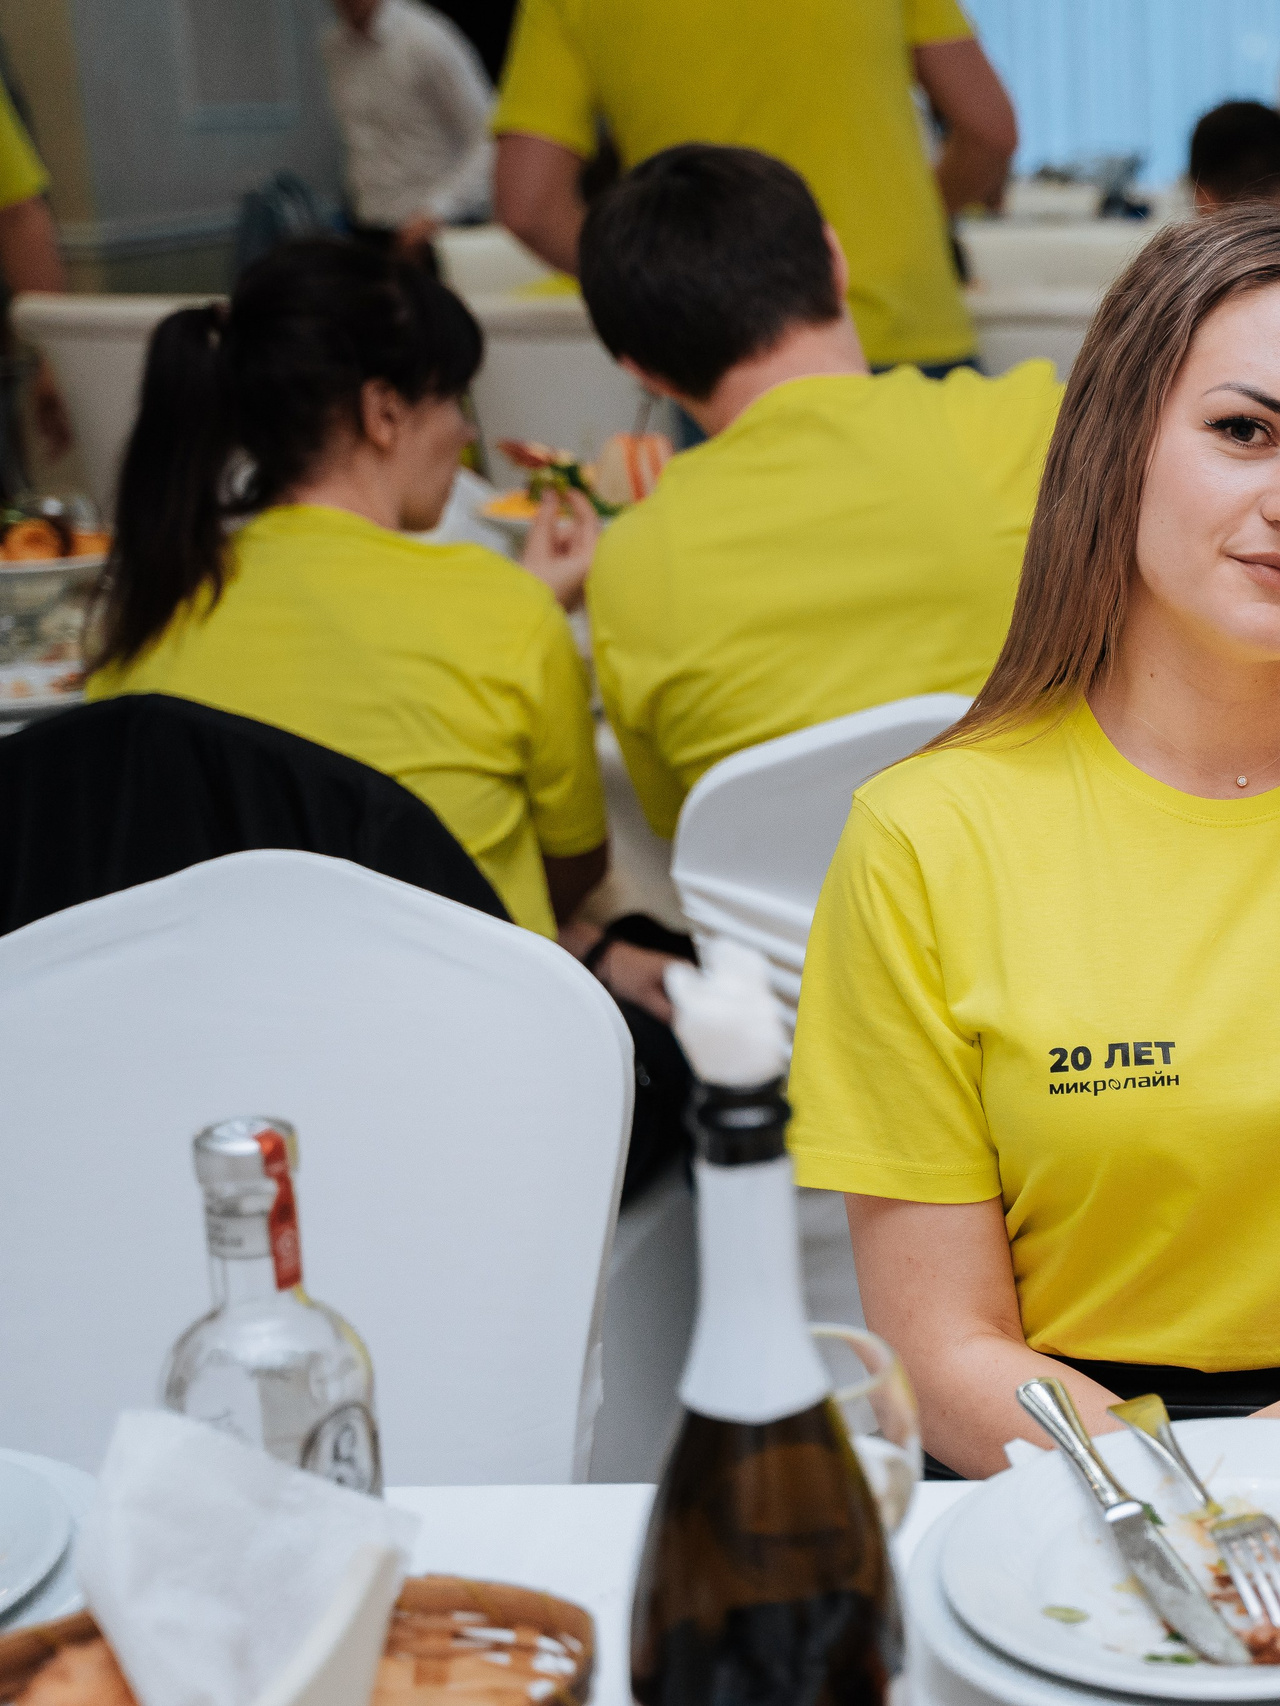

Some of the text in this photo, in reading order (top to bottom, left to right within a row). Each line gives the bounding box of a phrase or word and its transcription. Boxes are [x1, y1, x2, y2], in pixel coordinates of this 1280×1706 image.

[1048, 1041, 1175, 1073] 20 ЛЕТ
[1049, 1070, 1180, 1096] микролайн
